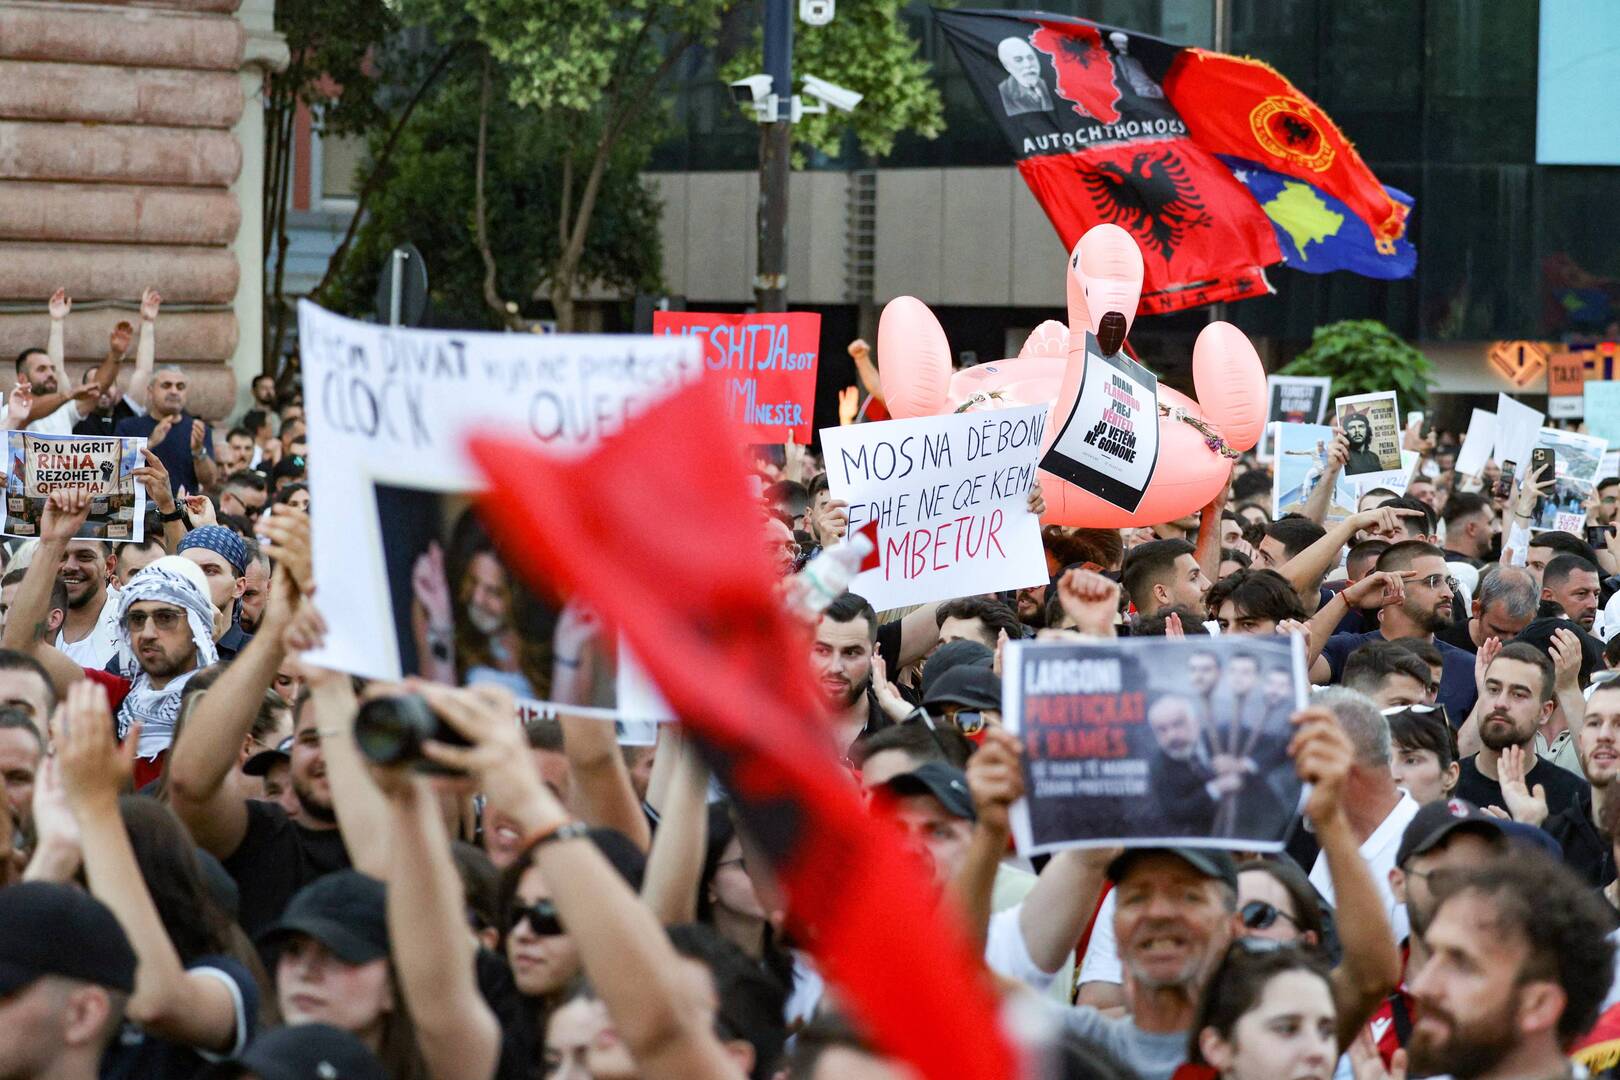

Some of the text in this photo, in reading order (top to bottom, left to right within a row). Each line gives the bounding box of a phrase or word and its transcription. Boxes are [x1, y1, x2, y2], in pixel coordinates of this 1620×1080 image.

[1023, 118, 1187, 153] AUTOCHTHONOUS
[381, 332, 468, 380] DIVAT
[664, 323, 789, 370] SHTJA
[1103, 381, 1140, 412] FLAMINGO
[1112, 374, 1133, 396] DUAM
[322, 370, 433, 449] CLOCK
[1111, 399, 1131, 419] PREJ
[1093, 420, 1108, 436] JO
[33, 442, 114, 454] PO U NGRIT
[37, 454, 96, 470] RINIA
[840, 410, 1048, 485] MOS NA DËBONI
[1097, 436, 1137, 464] GOMONE
[36, 470, 99, 481] REZOHET
[917, 484, 950, 522] NE
[952, 474, 987, 511] QE
[990, 457, 1037, 500] KEMI
[885, 508, 1006, 582] MBETUR
